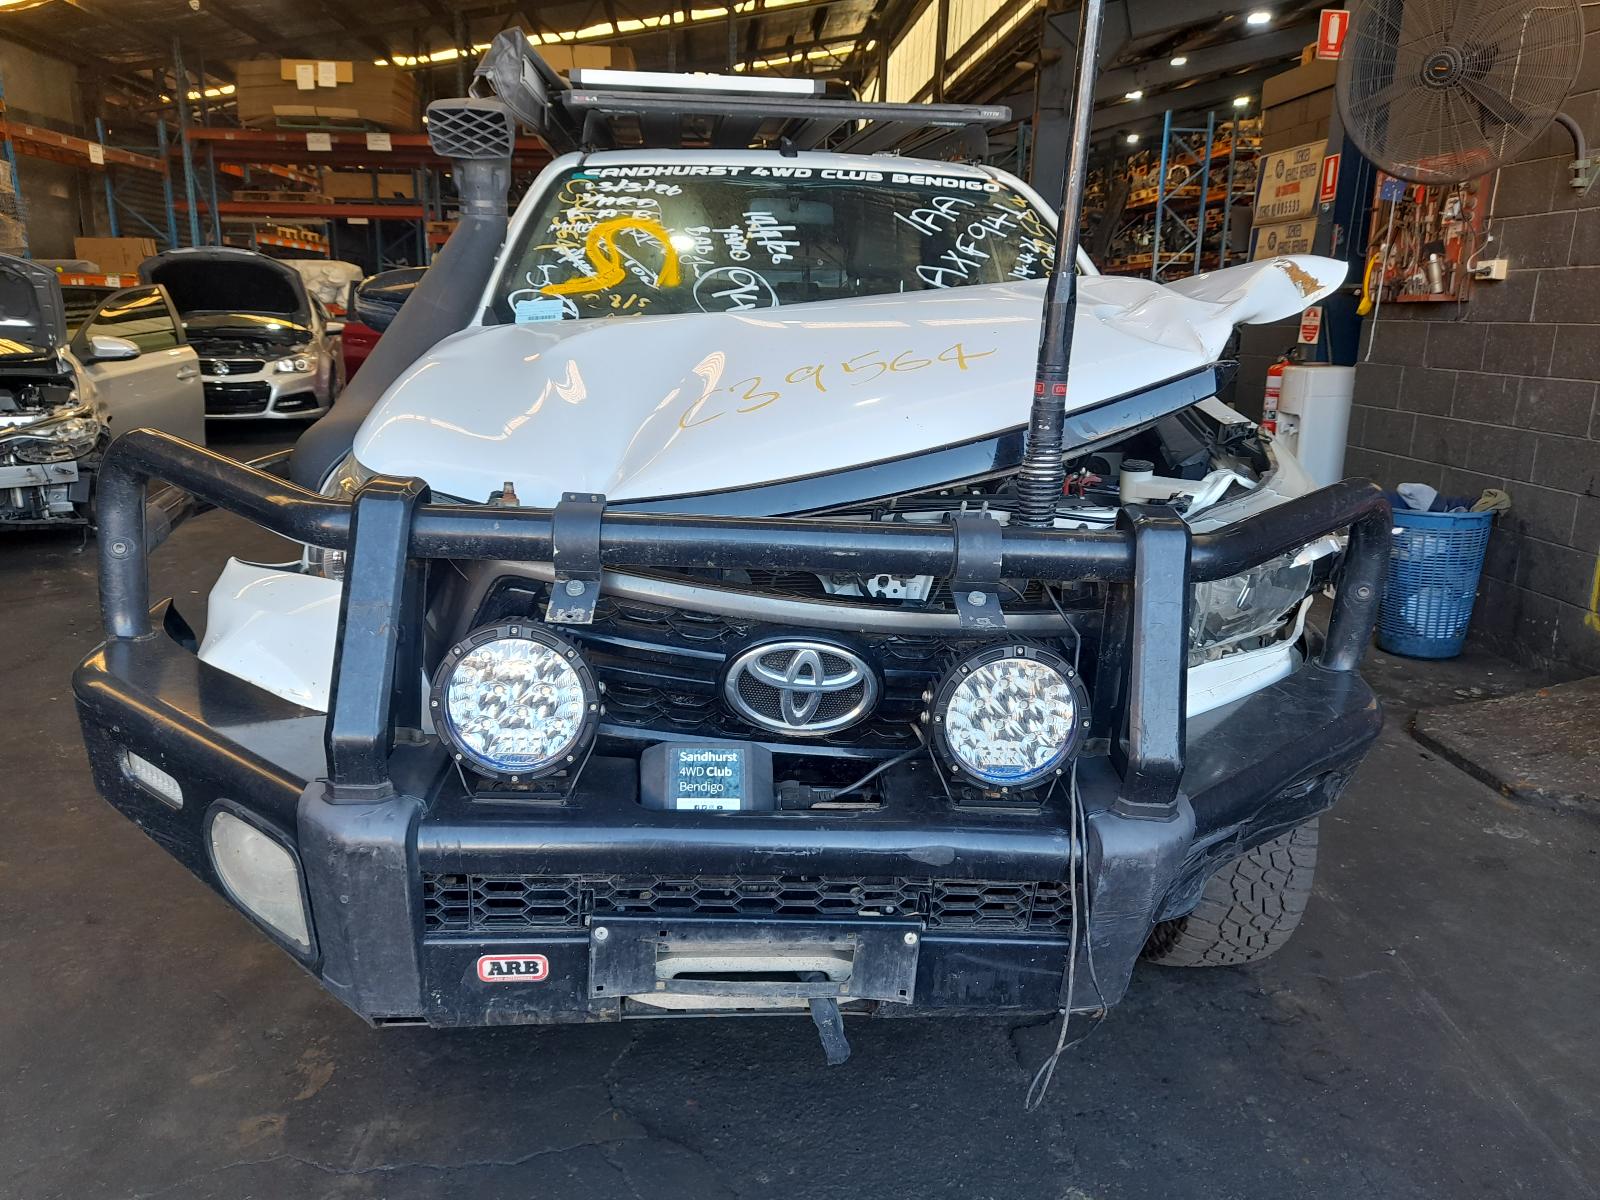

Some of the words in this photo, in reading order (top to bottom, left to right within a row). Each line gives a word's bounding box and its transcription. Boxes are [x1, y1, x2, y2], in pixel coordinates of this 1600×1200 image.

[751, 167, 812, 178] 4WD
[821, 169, 884, 182] CLUB
[891, 174, 1000, 192] BENDIGO
[680, 752, 738, 762] Sandhurst
[680, 767, 704, 777] 4WD
[706, 767, 733, 777] Club
[680, 782, 724, 794] Bendigo
[488, 960, 540, 976] ARB
